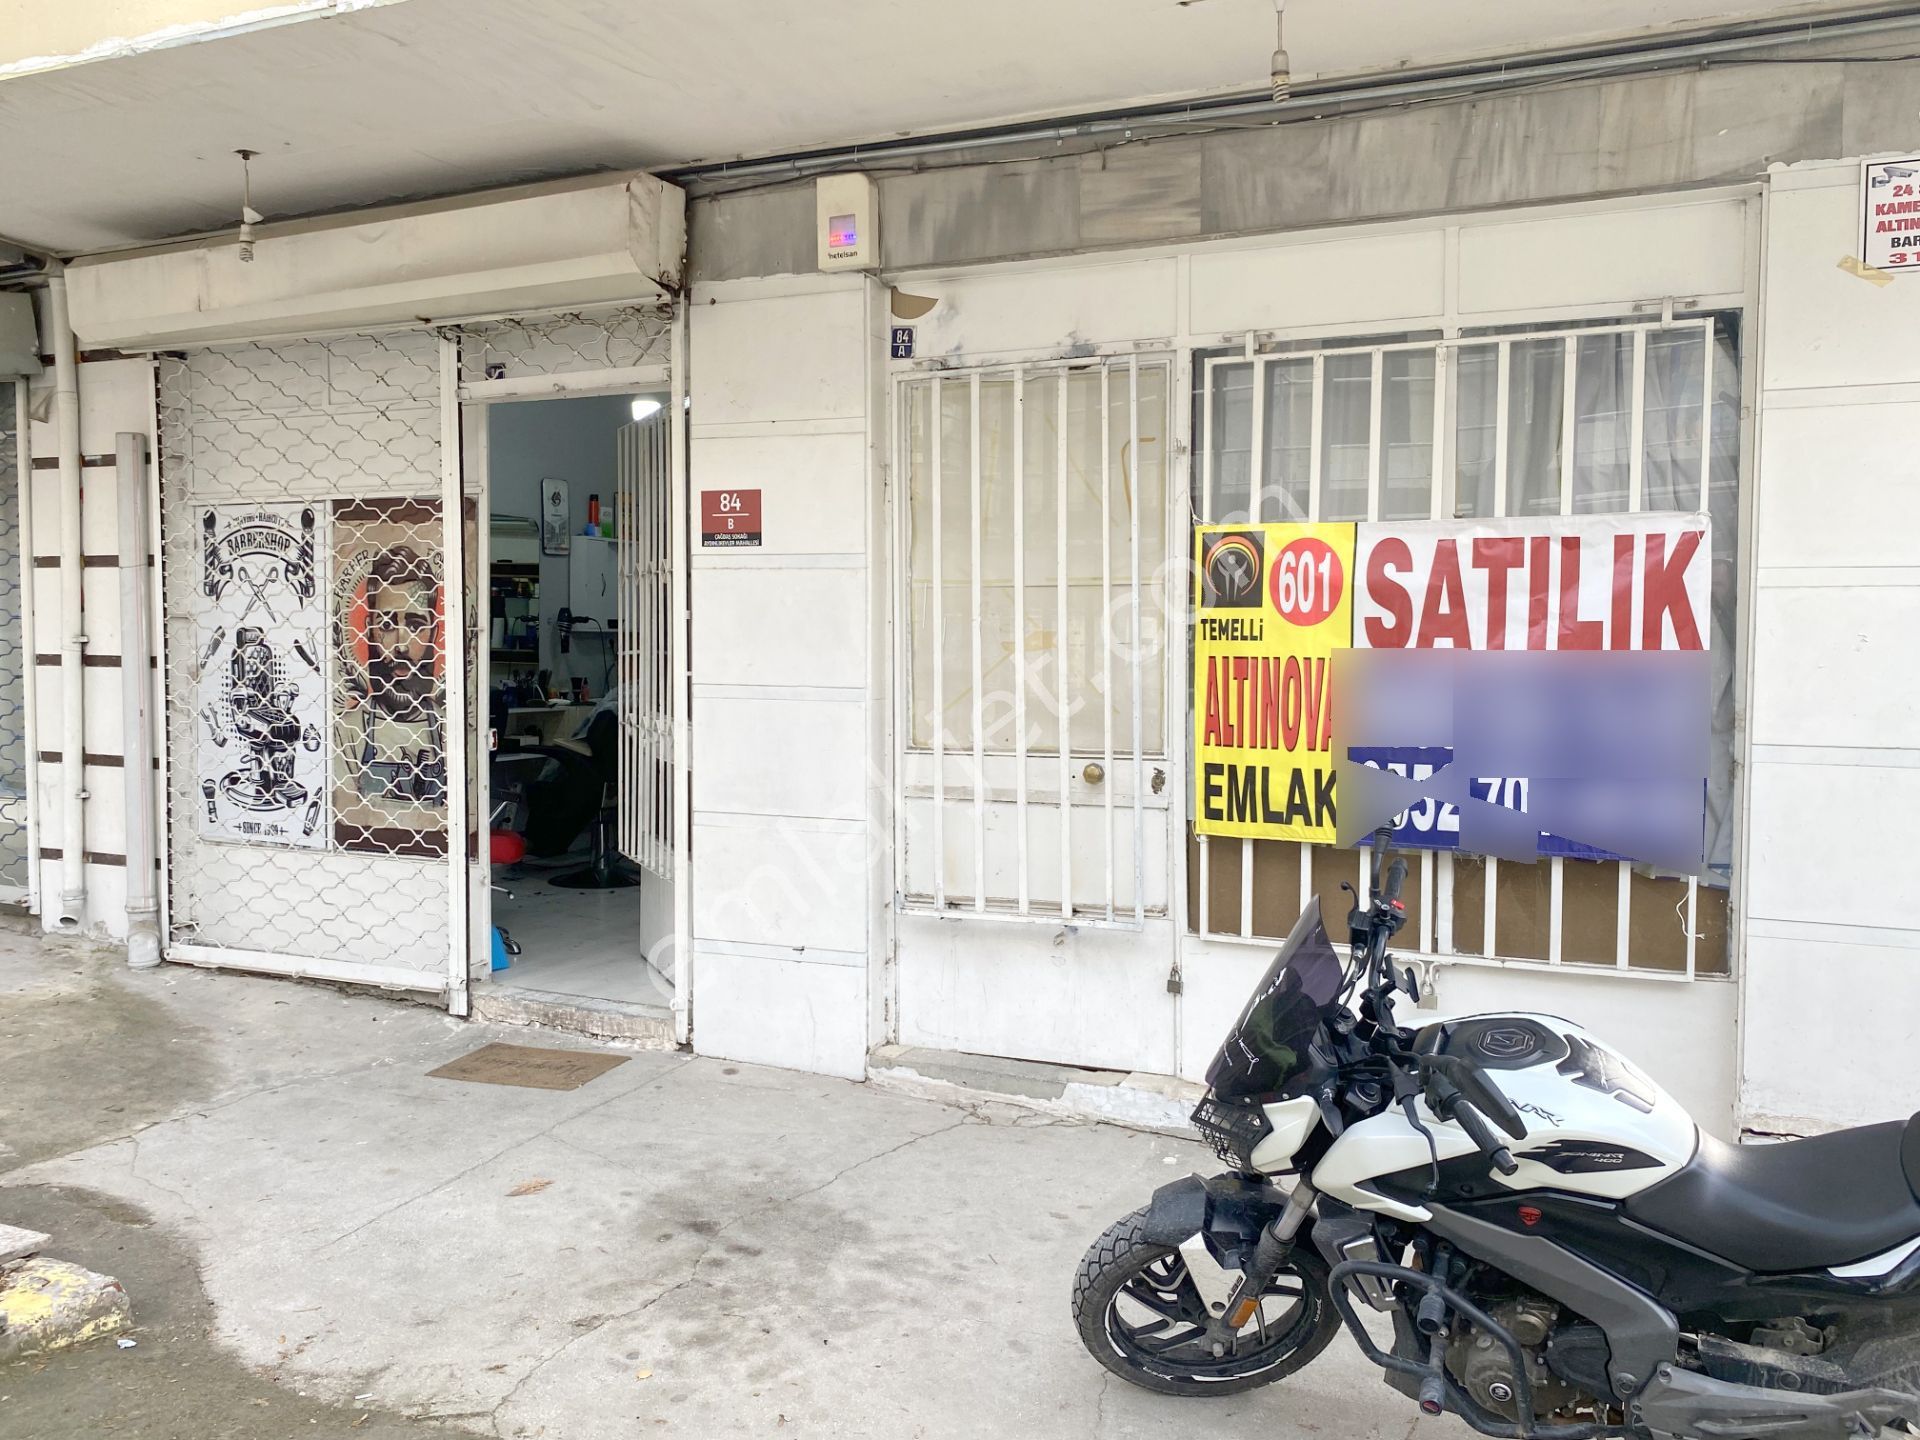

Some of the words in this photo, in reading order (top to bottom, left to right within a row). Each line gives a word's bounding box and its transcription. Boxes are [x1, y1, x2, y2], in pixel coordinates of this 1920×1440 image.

[1893, 184, 1914, 197] 24
[896, 330, 909, 344] 84
[898, 345, 906, 357] A
[720, 493, 741, 511] 84
[727, 518, 734, 530] B
[1278, 550, 1332, 614] 601
[1364, 530, 1706, 650] SATILIK
[1204, 762, 1336, 828] EMLAK
